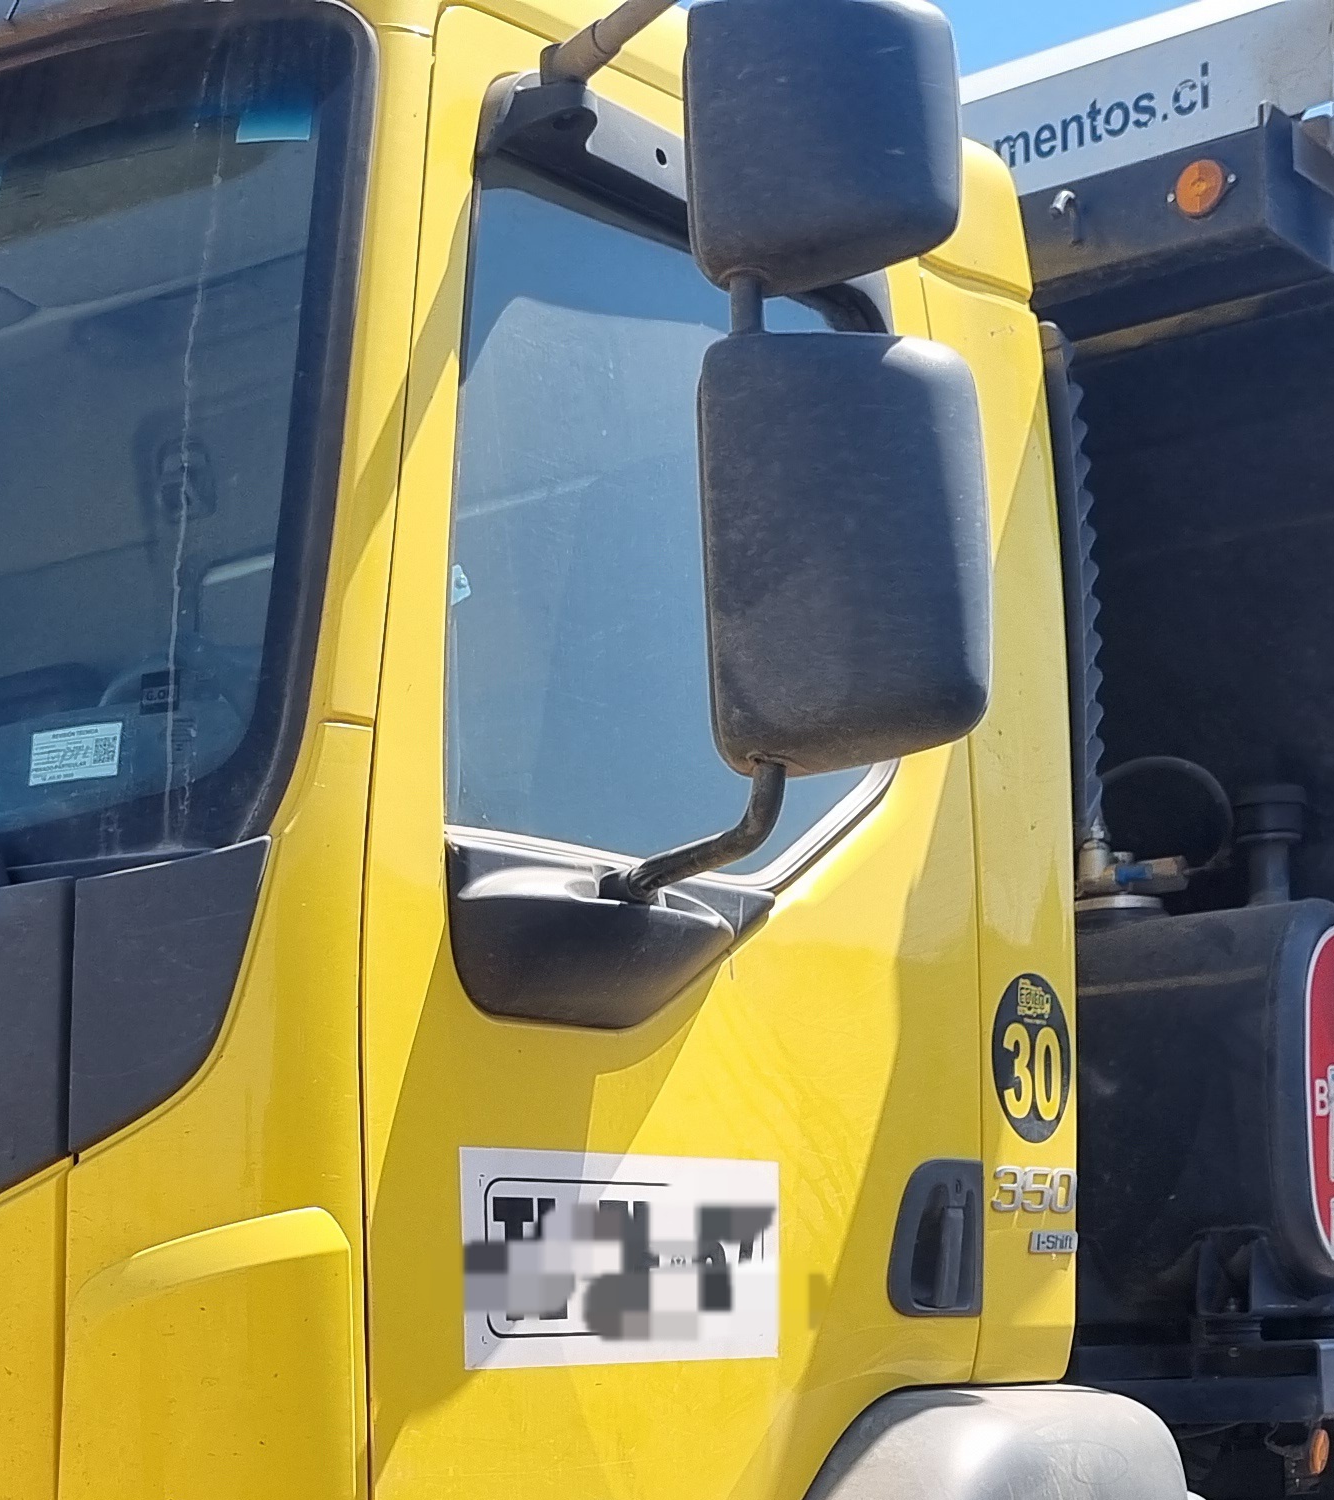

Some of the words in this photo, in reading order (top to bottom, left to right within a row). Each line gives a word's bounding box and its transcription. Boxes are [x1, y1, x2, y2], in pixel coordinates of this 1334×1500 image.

[1002, 1022, 1062, 1122] 30
[991, 1166, 1077, 1213] 350
[1036, 1233, 1073, 1251] I-Shift
